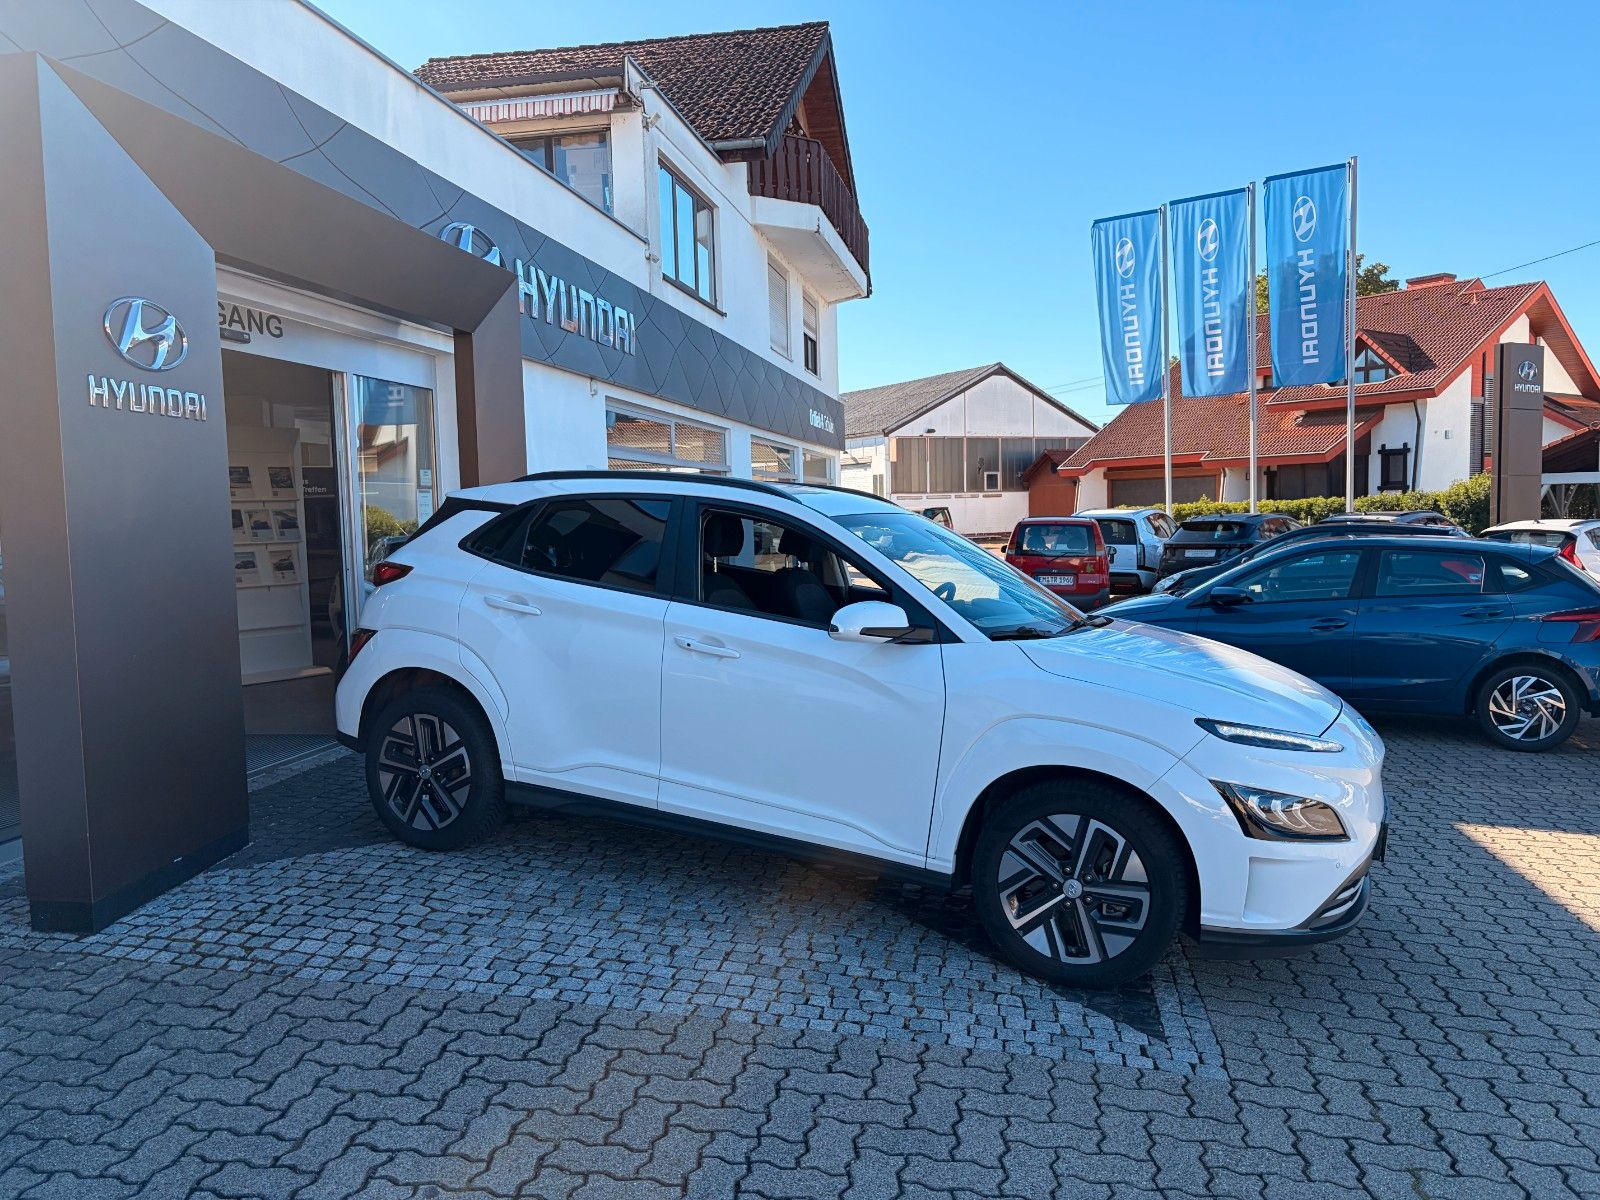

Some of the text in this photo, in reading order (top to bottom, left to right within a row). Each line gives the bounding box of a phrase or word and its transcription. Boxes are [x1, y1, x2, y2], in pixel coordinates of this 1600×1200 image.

[515, 258, 636, 357] HYUNDAI
[88, 374, 207, 422] HYUNDAI
[1514, 383, 1541, 393] HYUNDAI
